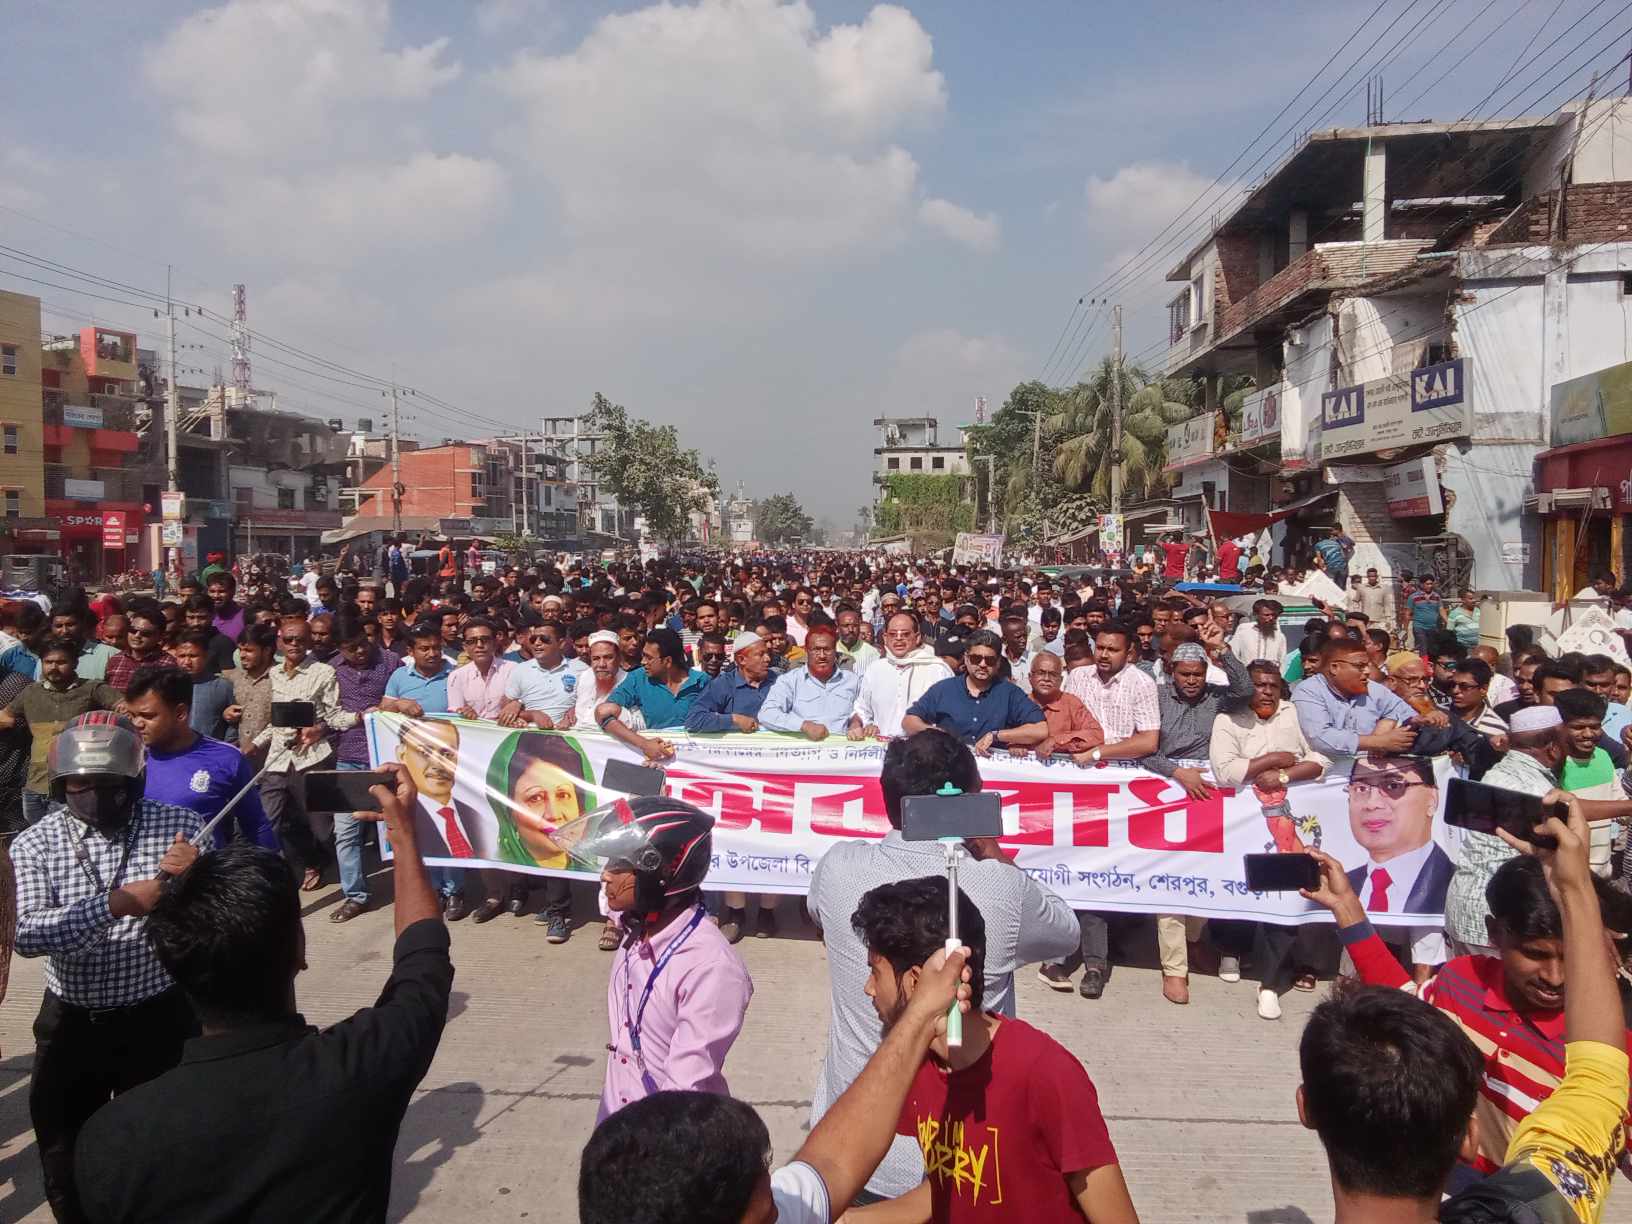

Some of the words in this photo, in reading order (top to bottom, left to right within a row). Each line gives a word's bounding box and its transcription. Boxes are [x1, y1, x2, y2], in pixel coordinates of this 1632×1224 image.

[1415, 367, 1455, 404] KAI
[1325, 391, 1358, 423] KAI
[727, 850, 789, 873] উপজেলা
[1077, 865, 1142, 893] সংগঠন,
[1149, 873, 1215, 898] শেরপুর,
